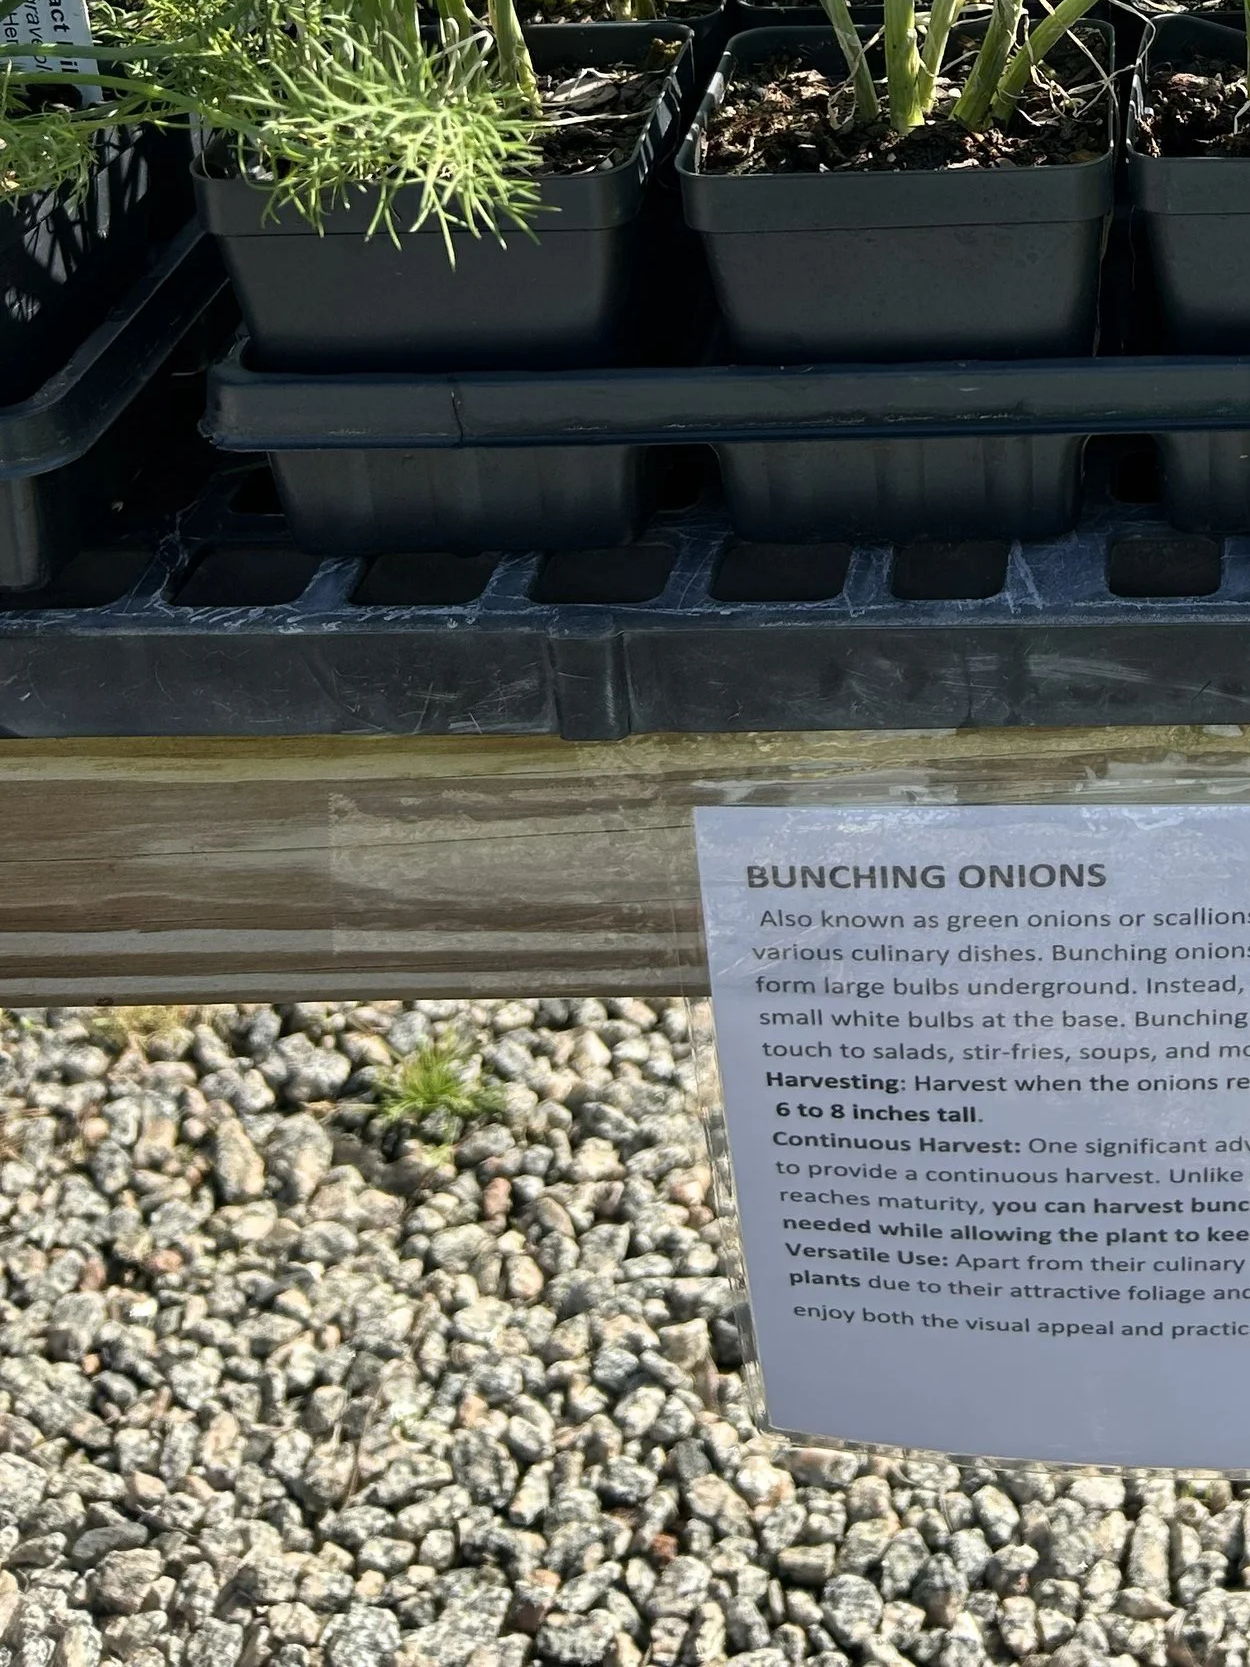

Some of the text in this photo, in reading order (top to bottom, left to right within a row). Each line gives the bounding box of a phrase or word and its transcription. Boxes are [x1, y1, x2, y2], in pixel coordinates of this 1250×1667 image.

[746, 863, 1107, 889] BUNCHING ONIONS
[759, 909, 813, 928] Also
[820, 909, 905, 929] known
[913, 915, 939, 929] as
[946, 914, 1019, 933] green
[1027, 909, 1111, 928] onions
[1118, 913, 1146, 927] or
[754, 975, 816, 994] form
[824, 976, 885, 999] large
[893, 977, 959, 996] bulbs
[967, 976, 1137, 999] underground.
[1146, 974, 1244, 995] Instead,
[759, 1008, 823, 1026] small
[830, 1009, 900, 1028] white
[908, 1010, 975, 1029] bulbs
[982, 1012, 1006, 1029] at
[1012, 1010, 1054, 1028] the
[1062, 1009, 1126, 1028] base.
[1135, 1008, 1249, 1029] Bunching
[761, 1041, 832, 1058] touch
[839, 1043, 866, 1059] to
[872, 1042, 954, 1064] salads,
[962, 1042, 1071, 1063] stir-fries,
[1079, 1046, 1157, 1064] soups,
[1165, 1040, 1210, 1059] and
[765, 1071, 906, 1095] Harvesting:
[914, 1075, 1008, 1092] Harvest
[1014, 1074, 1082, 1092] when
[1088, 1074, 1130, 1092] the
[1137, 1074, 1219, 1092] onions
[775, 1101, 984, 1123] 6 to 8 inches tall.
[772, 1131, 912, 1152] Continuous
[919, 1137, 1021, 1154] Harvest:
[1028, 1137, 1078, 1154] One
[1085, 1137, 1207, 1158] significant
[779, 1189, 871, 1207] reaches
[878, 1196, 985, 1216] maturity,
[991, 1201, 1037, 1217] you
[1044, 1201, 1086, 1214] can
[1093, 1197, 1184, 1215] harvest
[784, 1242, 890, 1263] Versatile
[897, 1250, 949, 1267] Use:
[955, 1253, 1021, 1272] Apart
[1026, 1254, 1083, 1271] from
[1089, 1256, 1147, 1272] their
[1152, 1256, 1246, 1275] culinary
[789, 1269, 861, 1288] plants
[868, 1274, 910, 1292] due
[916, 1280, 942, 1294] to
[947, 1280, 1003, 1297] their
[1010, 1284, 1121, 1301] attractive
[1127, 1285, 1206, 1304] foliage
[793, 1305, 855, 1324] enjoy
[862, 1307, 914, 1326] both
[920, 1313, 959, 1329] the
[965, 1317, 1030, 1333] visual
[1037, 1320, 1114, 1338] appeal
[1121, 1321, 1164, 1337] and
